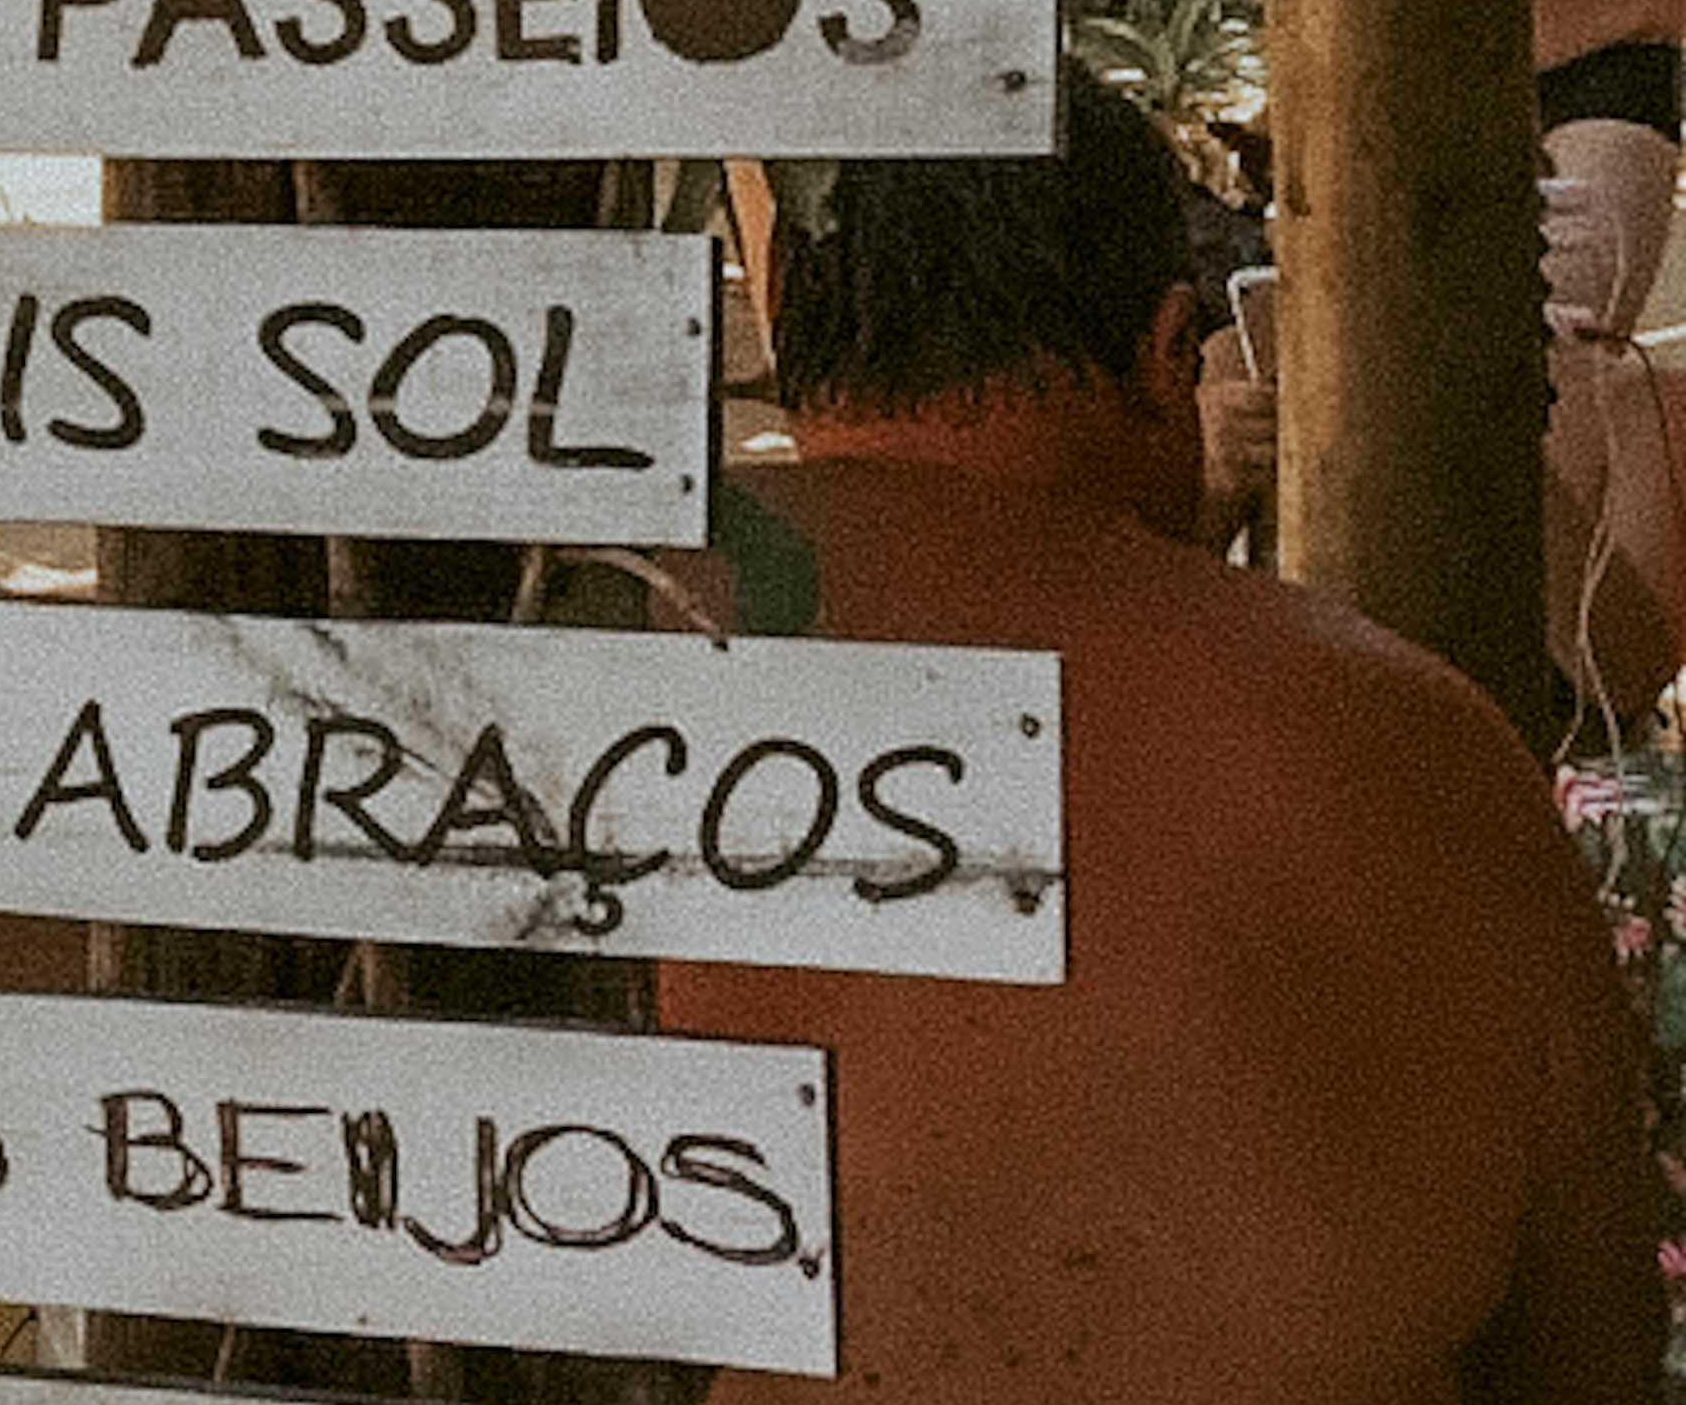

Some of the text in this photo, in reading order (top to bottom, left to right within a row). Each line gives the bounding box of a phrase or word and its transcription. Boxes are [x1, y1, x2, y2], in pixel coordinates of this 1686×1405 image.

[258, 301, 656, 469] SOL
[15, 701, 966, 936] ABRAÇOS
[98, 1088, 800, 1265] BEIJOS
